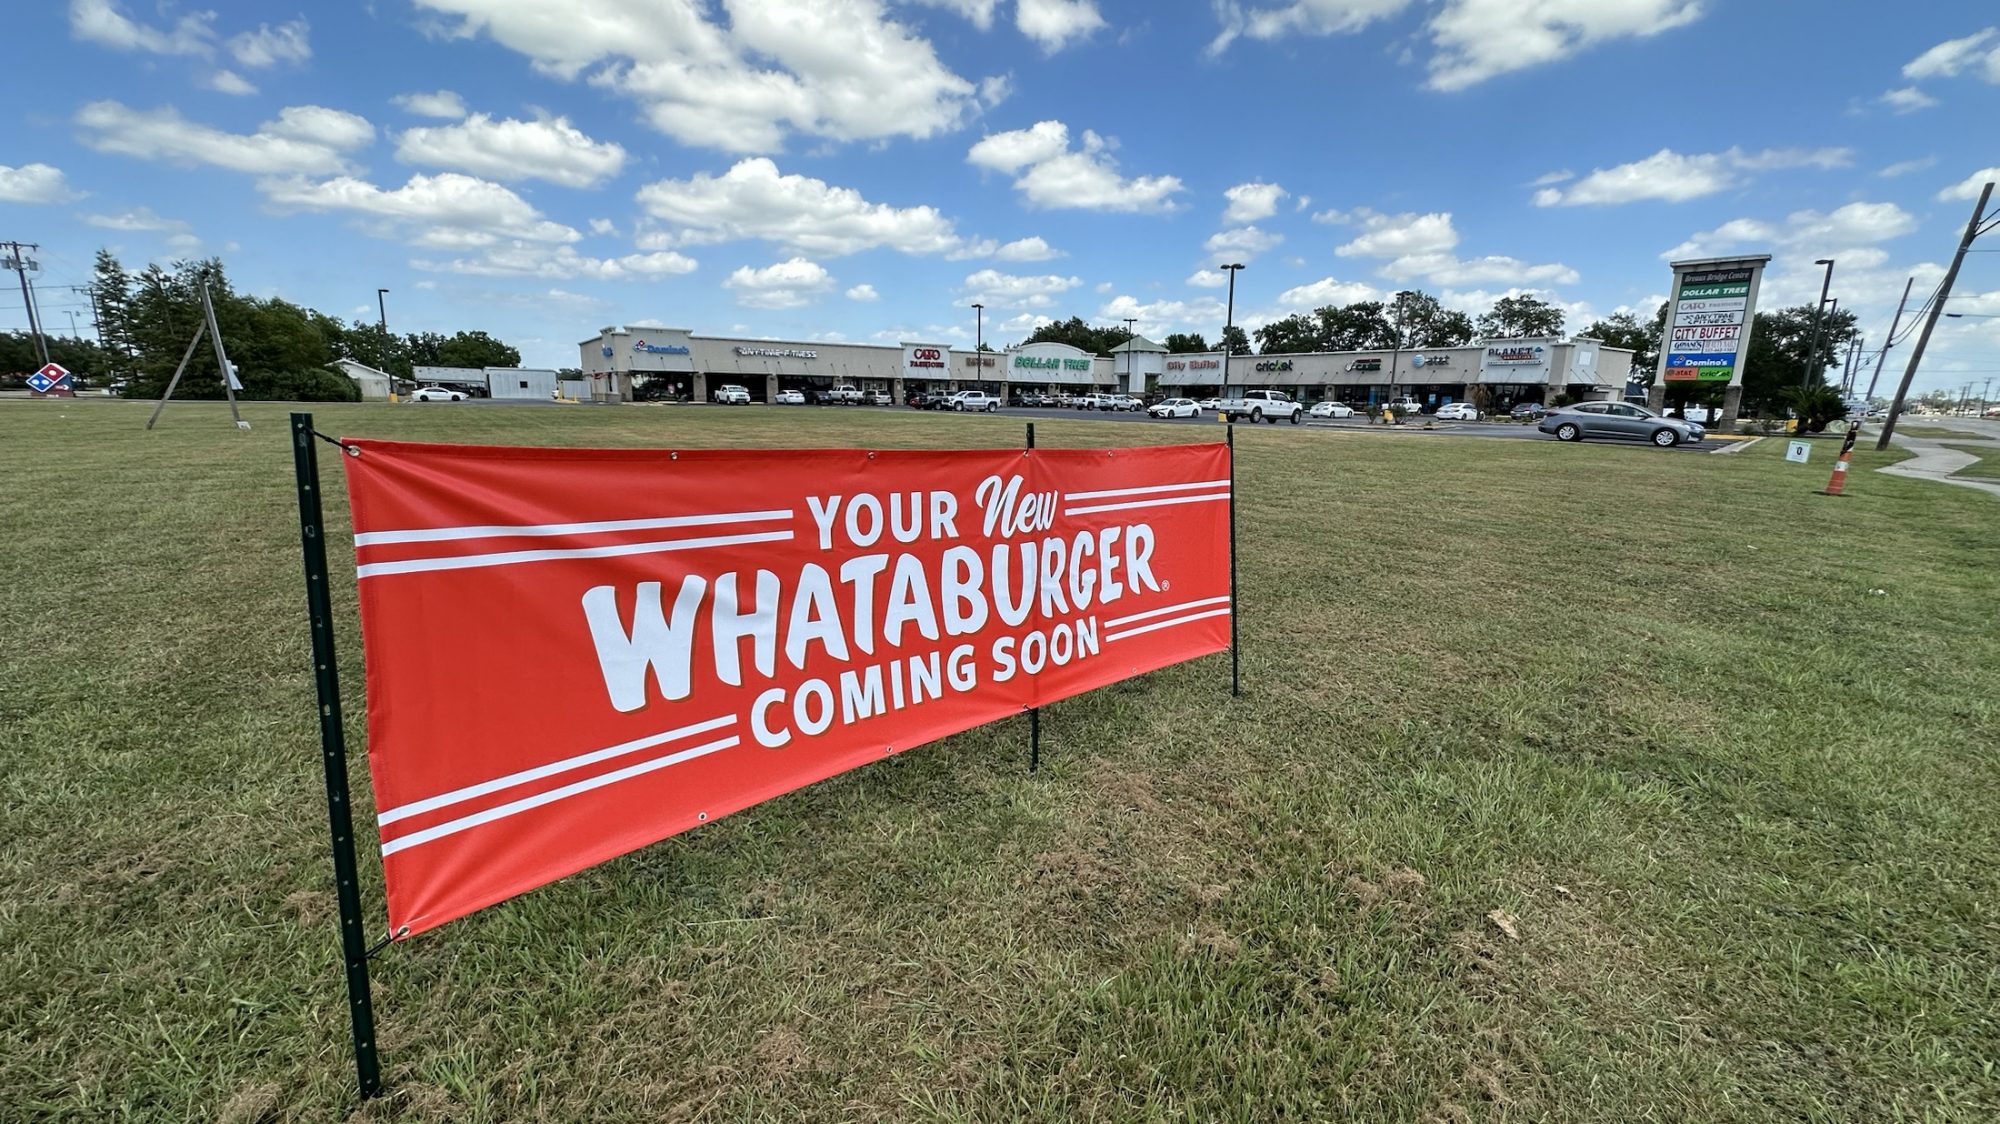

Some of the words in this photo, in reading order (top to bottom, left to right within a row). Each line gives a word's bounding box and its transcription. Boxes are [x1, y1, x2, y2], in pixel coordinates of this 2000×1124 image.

[1682, 288, 1719, 297] DOLLAR
[1681, 303, 1706, 311] CATO
[1675, 329, 1698, 340] CITY
[1699, 327, 1738, 339] BUFFET
[647, 345, 689, 355] Domino's
[914, 348, 941, 360] CATO
[1488, 347, 1533, 357] PLANET
[910, 360, 945, 369] FASHIONS
[1015, 356, 1060, 369] DOLLAR
[1063, 358, 1091, 371] TREE
[1255, 359, 1294, 372] cricket
[806, 491, 958, 551] YOUR
[975, 474, 1058, 539] New
[582, 523, 1163, 713] WHATABURGER
[750, 644, 976, 749] COMING
[992, 615, 1099, 683] SOON
